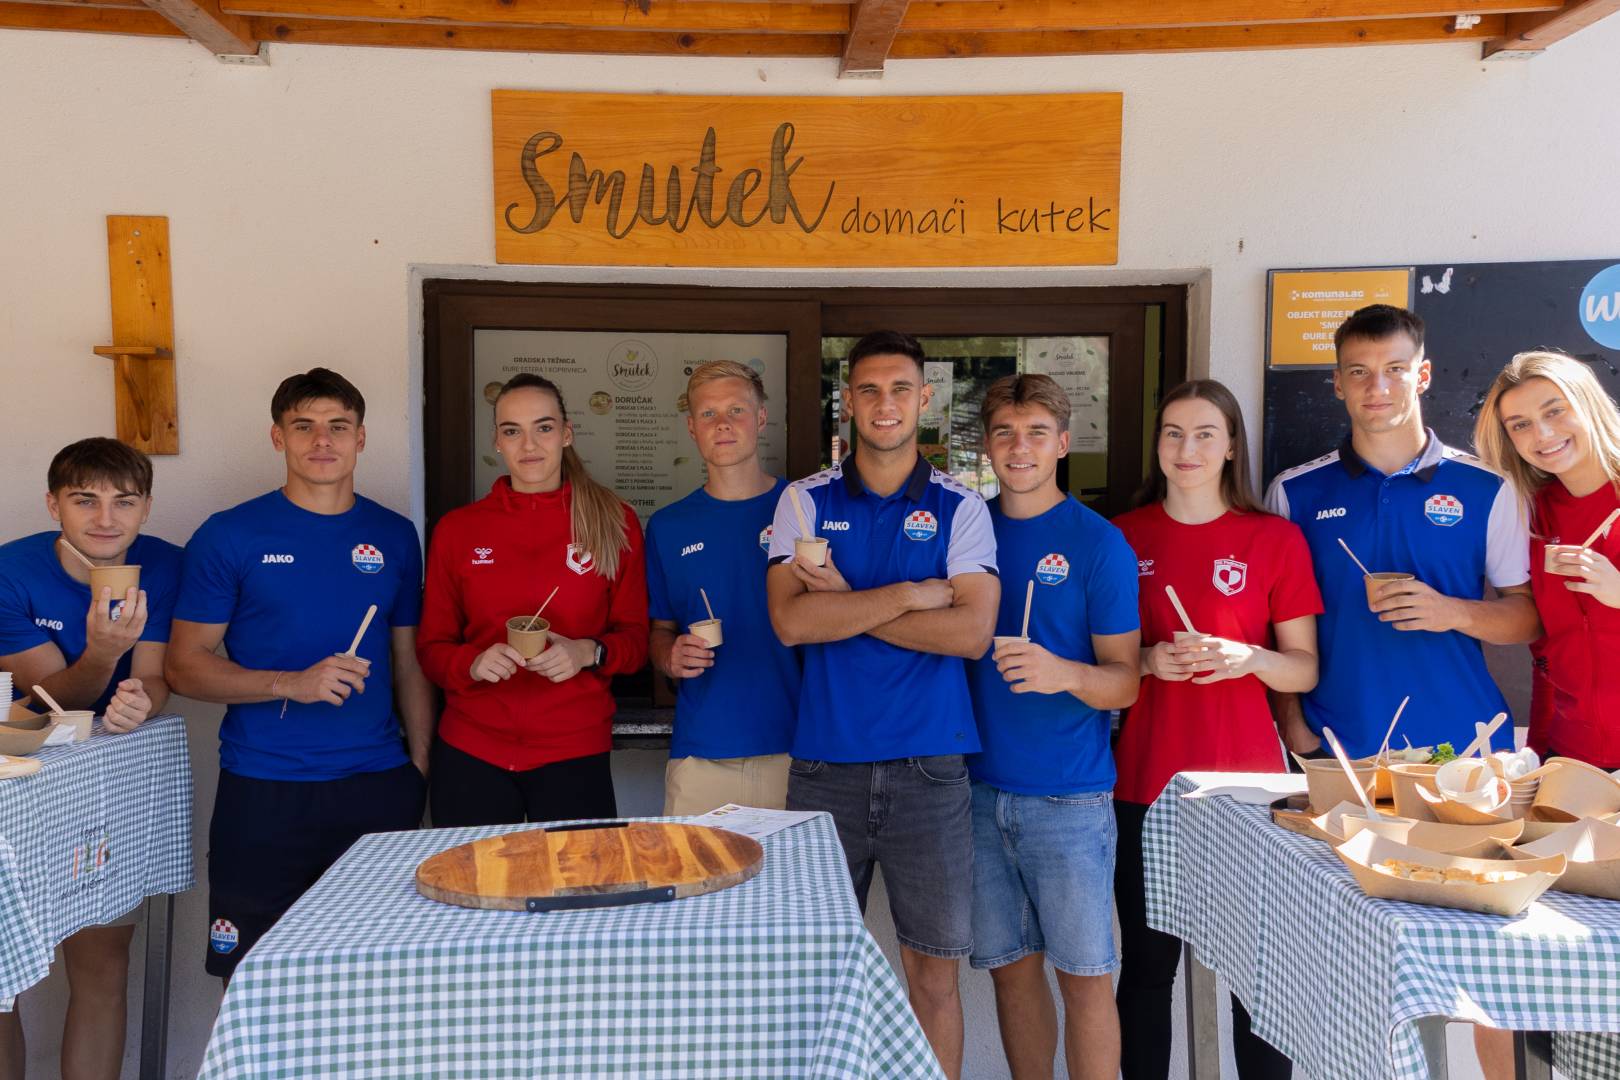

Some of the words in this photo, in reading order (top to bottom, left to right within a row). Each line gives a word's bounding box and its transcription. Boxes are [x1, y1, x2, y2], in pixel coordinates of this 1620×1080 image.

[506, 121, 834, 240] Smutek
[841, 197, 966, 235] domaći
[997, 197, 1111, 235] kutek
[615, 395, 653, 403] DORUČAK
[1315, 507, 1347, 520] JAKO
[1428, 505, 1460, 514] SLAVEN
[821, 520, 850, 531] JAKO
[906, 522, 935, 530] SLAVEN
[681, 542, 704, 556] JAKO
[261, 554, 294, 563] JAKO
[1039, 565, 1067, 573] SLAVEN
[211, 931, 236, 941] SLAVEN
